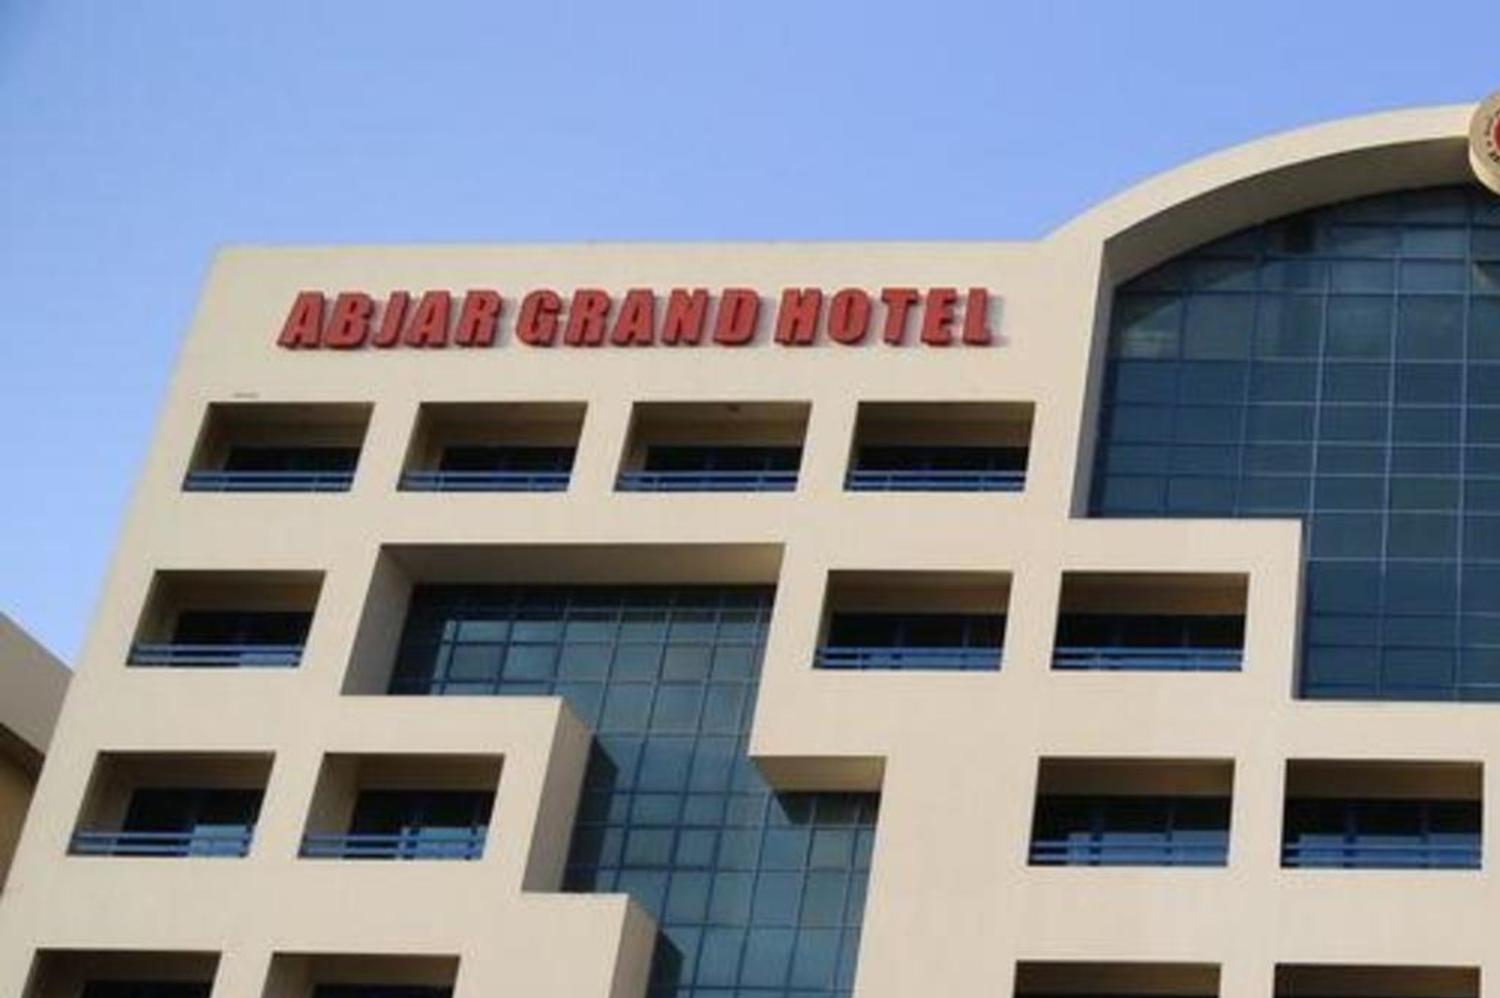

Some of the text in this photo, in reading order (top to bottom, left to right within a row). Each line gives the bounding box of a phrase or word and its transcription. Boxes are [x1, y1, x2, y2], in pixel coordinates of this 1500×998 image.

[278, 287, 994, 349] ABJAR GRAND HOTEL
